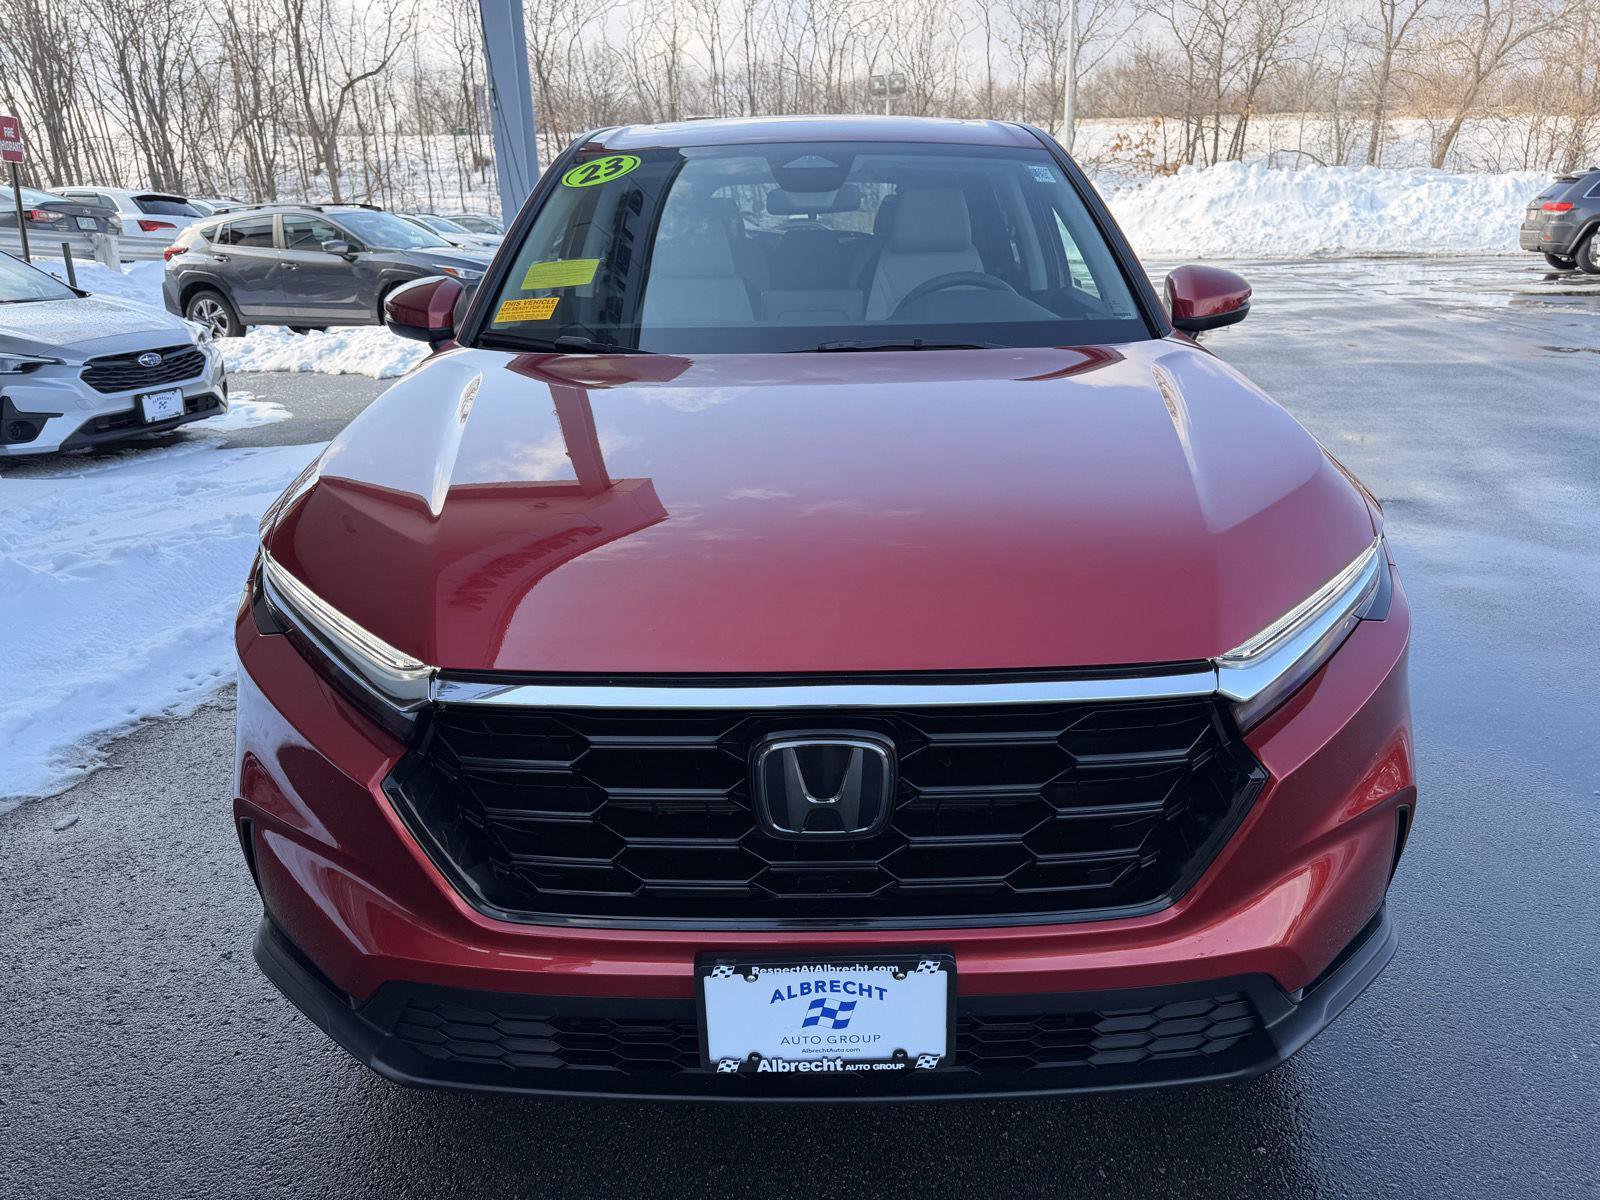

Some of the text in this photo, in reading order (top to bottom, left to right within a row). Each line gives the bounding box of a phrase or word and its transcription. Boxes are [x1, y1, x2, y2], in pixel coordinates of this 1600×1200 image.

[578, 157, 625, 184] 23
[751, 964, 899, 975] RespectAtAlbrecht.com
[769, 979, 888, 1005] ALBRECHT
[780, 1034, 881, 1046] AUTO GROUP
[801, 1046, 861, 1054] AlbrechtAuto.com
[757, 1057, 844, 1073] Albrecht
[872, 1063, 905, 1071] GROUP
